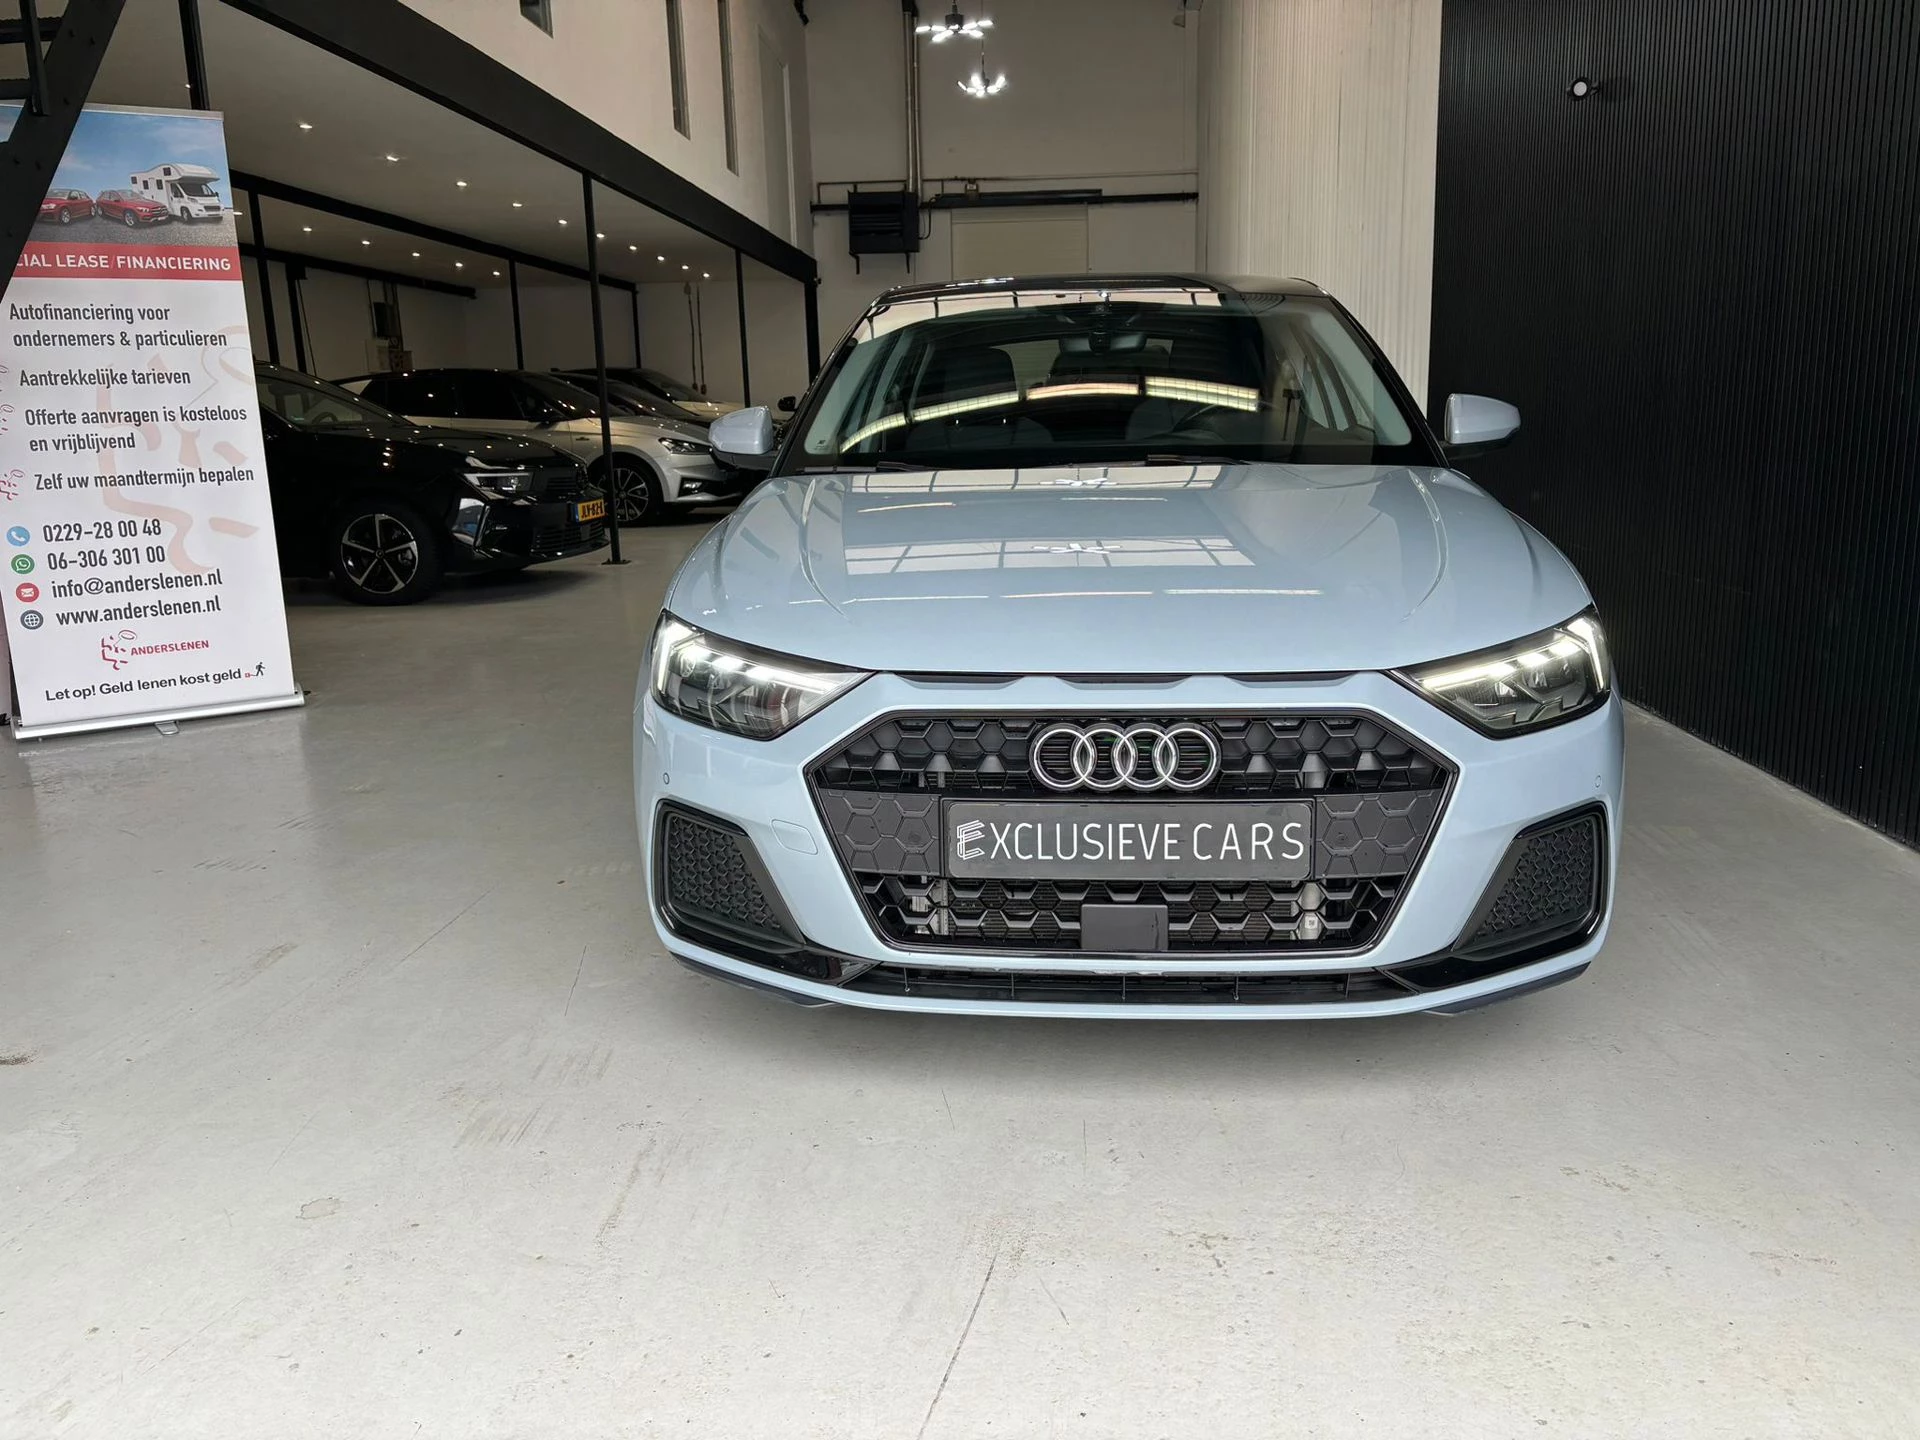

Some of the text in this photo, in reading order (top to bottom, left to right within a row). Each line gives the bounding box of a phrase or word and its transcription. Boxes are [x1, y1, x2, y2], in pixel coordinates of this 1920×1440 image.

[56, 254, 109, 268] LEASE
[116, 255, 231, 271] FINANCIERING
[9, 303, 170, 325] Autofinanciering voor
[13, 331, 227, 351] ondernemers & particulieren
[19, 369, 191, 389] Aantrekkelijke tarieven
[25, 405, 248, 427] Offerte aanvragen is kosteloos
[29, 432, 136, 454] en vrijblijvend
[35, 466, 254, 490] Zelf uw maandtermijn bepalen
[43, 518, 162, 543] 0229-28 00 48
[47, 545, 166, 571] 06-306 301 00
[52, 568, 223, 598] info@anderslenen.nl
[56, 595, 221, 626] www.anderslenen.nl
[130, 640, 210, 656] ANDERSLENEN
[45, 669, 242, 702] Let op! Geld lenen kost geld
[956, 819, 1305, 861] EXCLUSIEVE CARS
